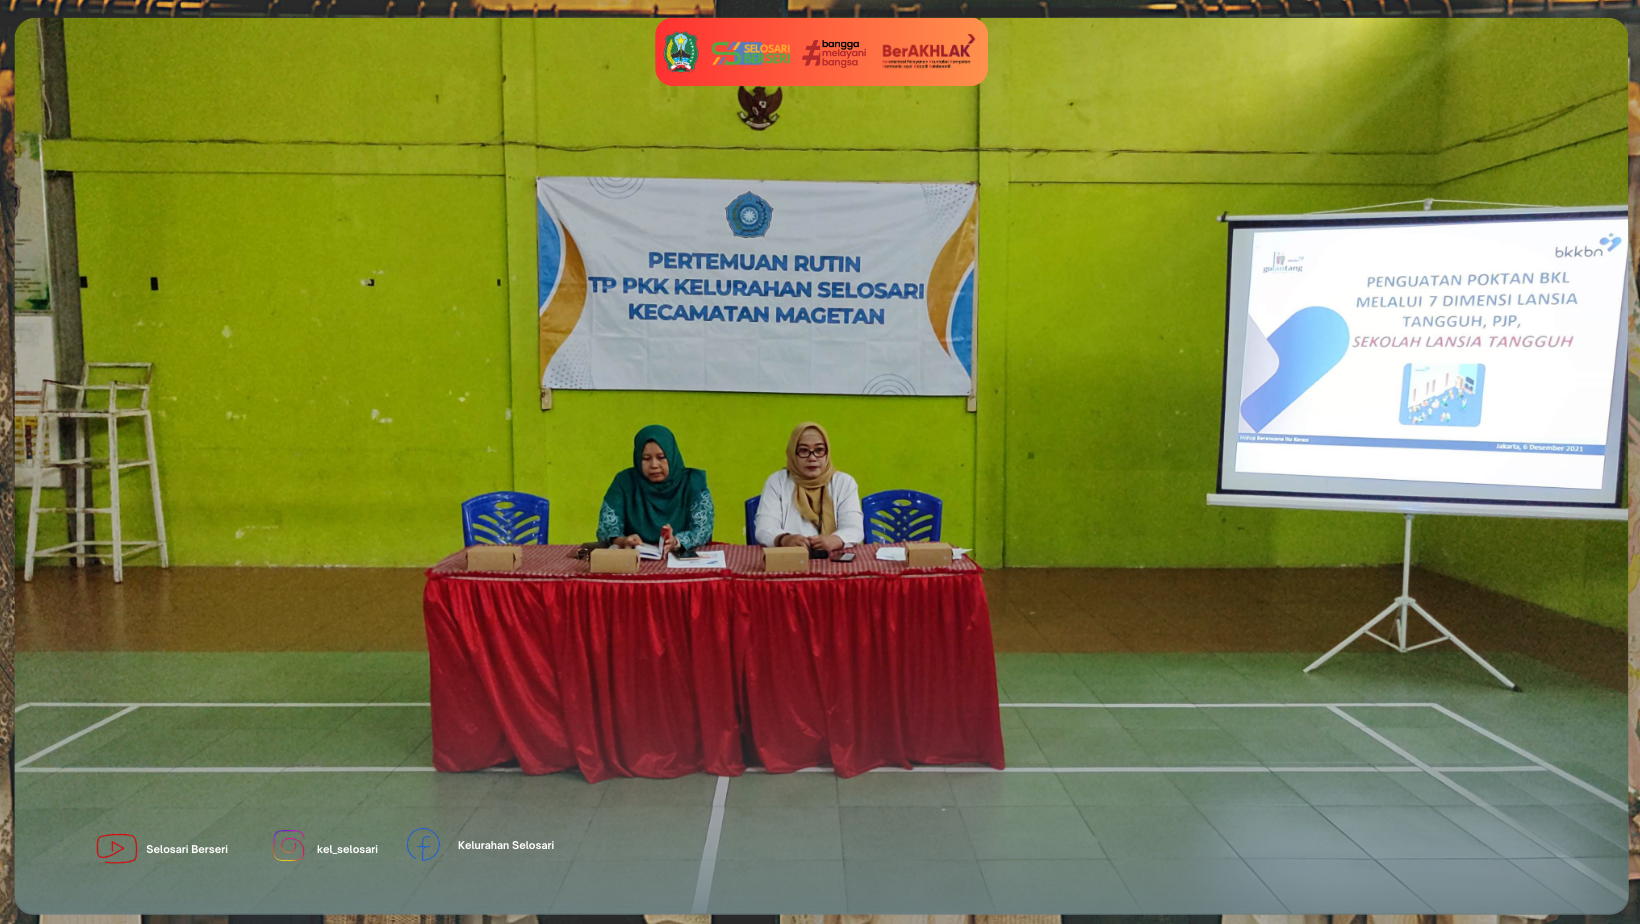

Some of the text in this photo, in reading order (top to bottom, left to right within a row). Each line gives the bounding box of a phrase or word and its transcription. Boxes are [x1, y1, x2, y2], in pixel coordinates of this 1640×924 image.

[1555, 245, 1603, 258] bkkbn
[648, 251, 861, 273] PERTEMUAN RUTIN
[1366, 271, 1571, 288] PENGUATAN POKTAN BKL
[588, 276, 925, 300] TP PKK KELURAHAN SELOSARI
[1356, 292, 1579, 308] MELALUI 7 DIMENSI LANSIA
[628, 303, 886, 325] KECAMATAN MAGETAN
[1402, 314, 1522, 329] TANGGUH, PJP,
[1352, 335, 1574, 348] SEKOLAH LANSIA TANGGUH
[1496, 443, 1521, 451] Jakarta,
